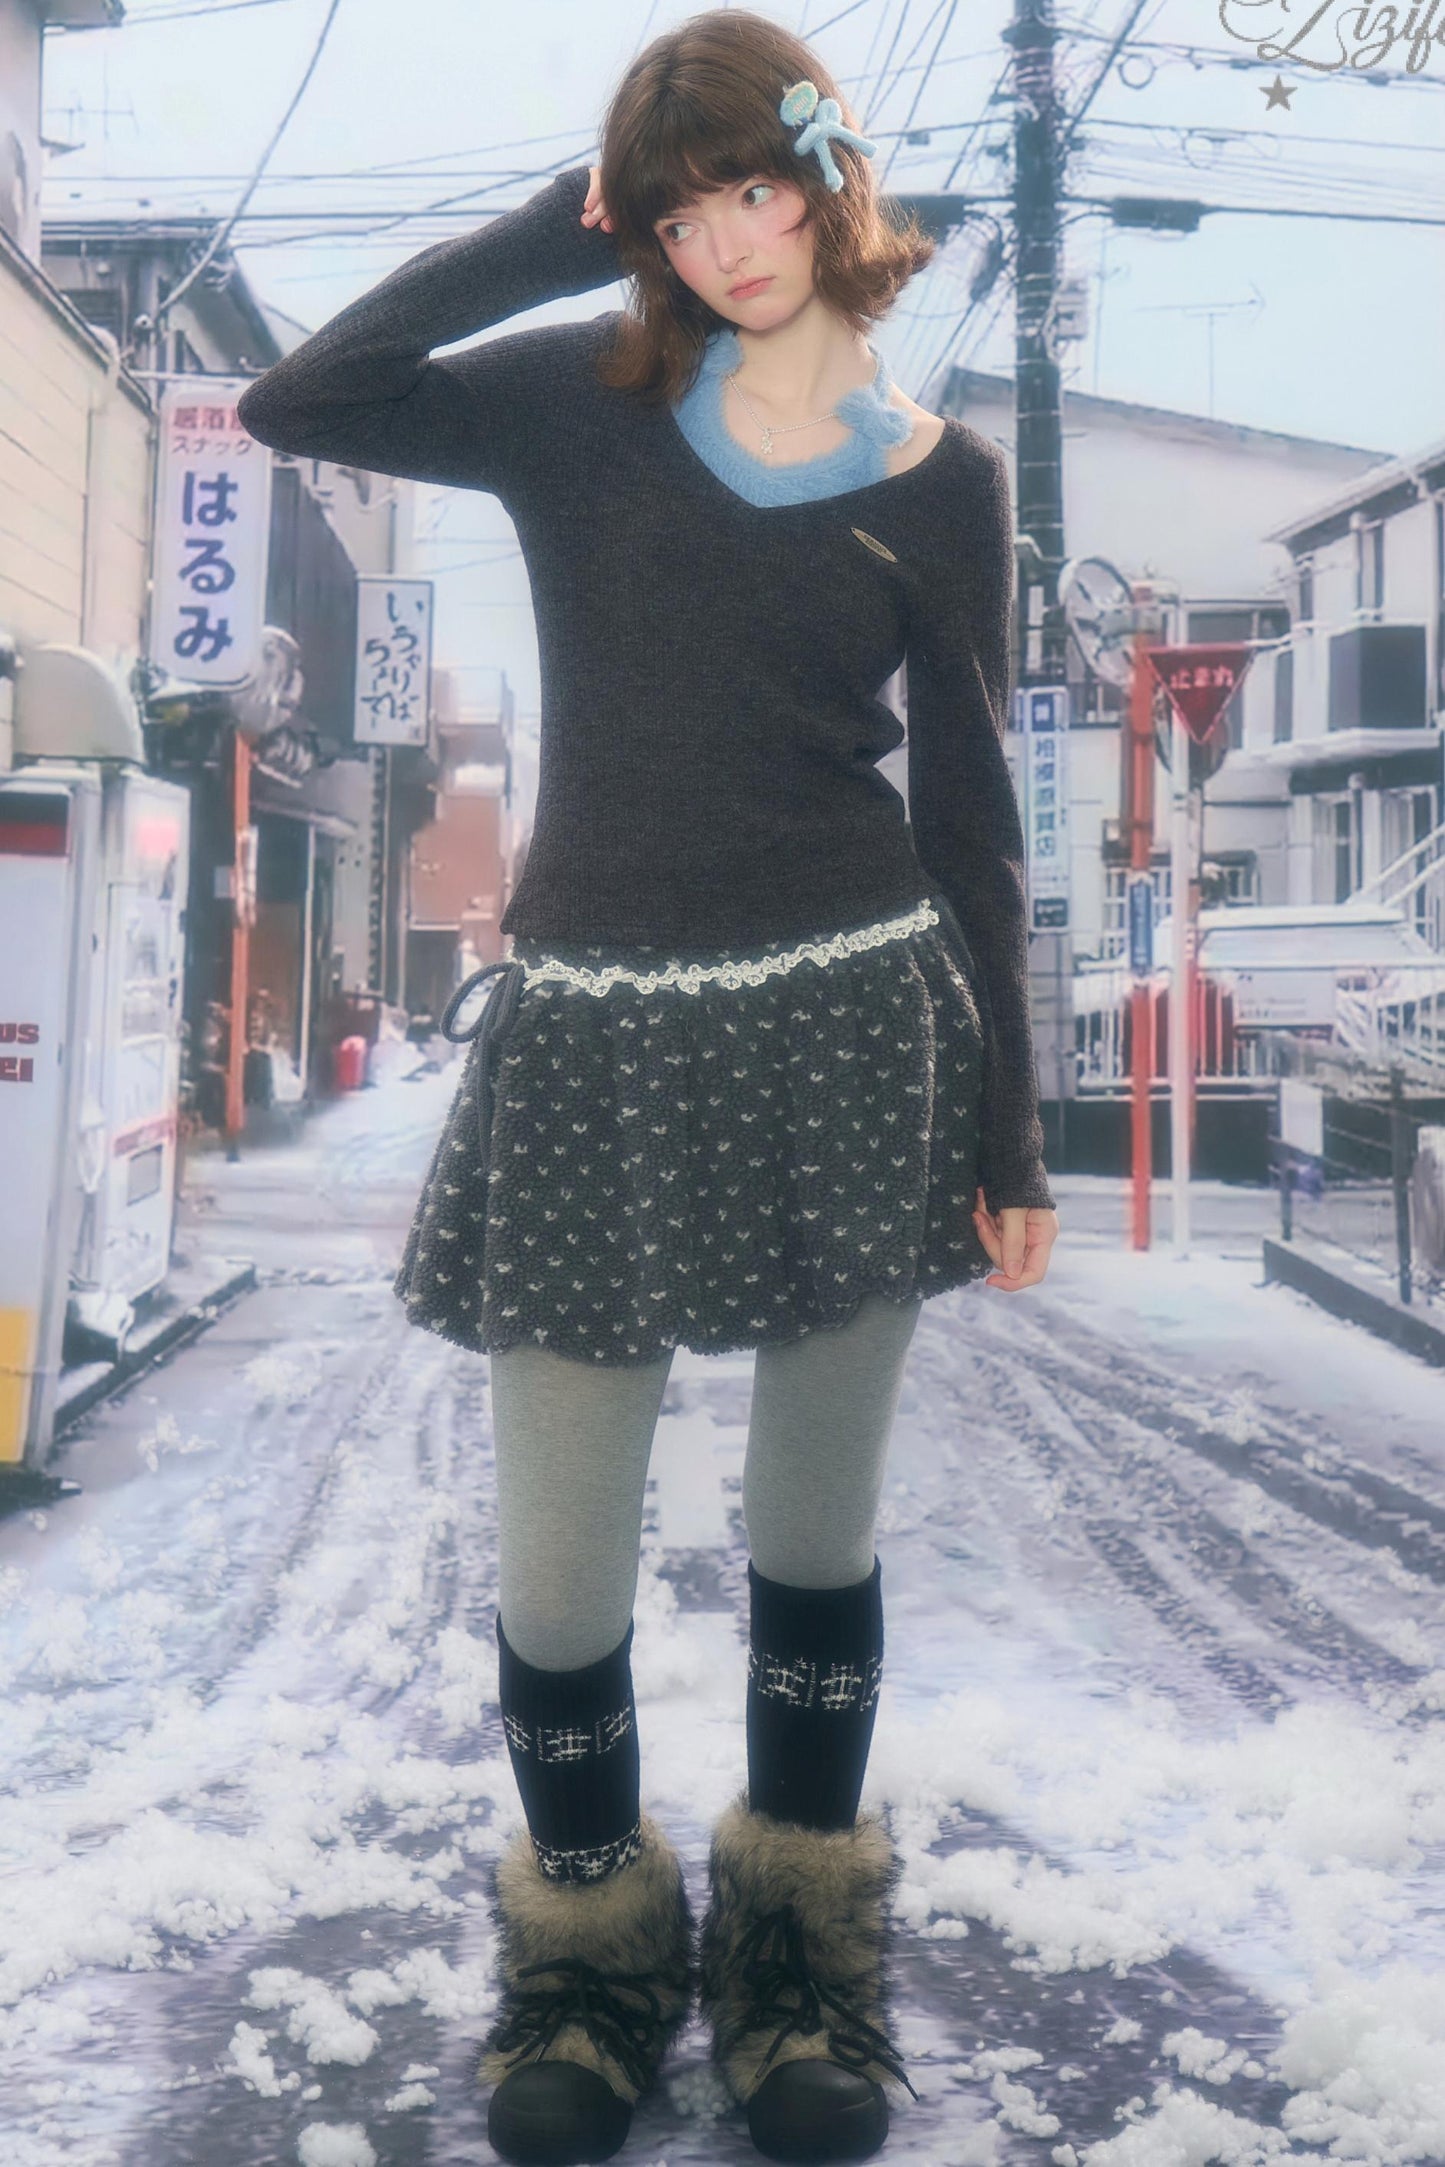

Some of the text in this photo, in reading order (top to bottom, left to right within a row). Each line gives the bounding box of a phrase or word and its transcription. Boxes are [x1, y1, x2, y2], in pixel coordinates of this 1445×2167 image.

[171, 436, 252, 455] スナック
[173, 471, 238, 663] はるみ
[1169, 666, 1234, 690] 止まれ
